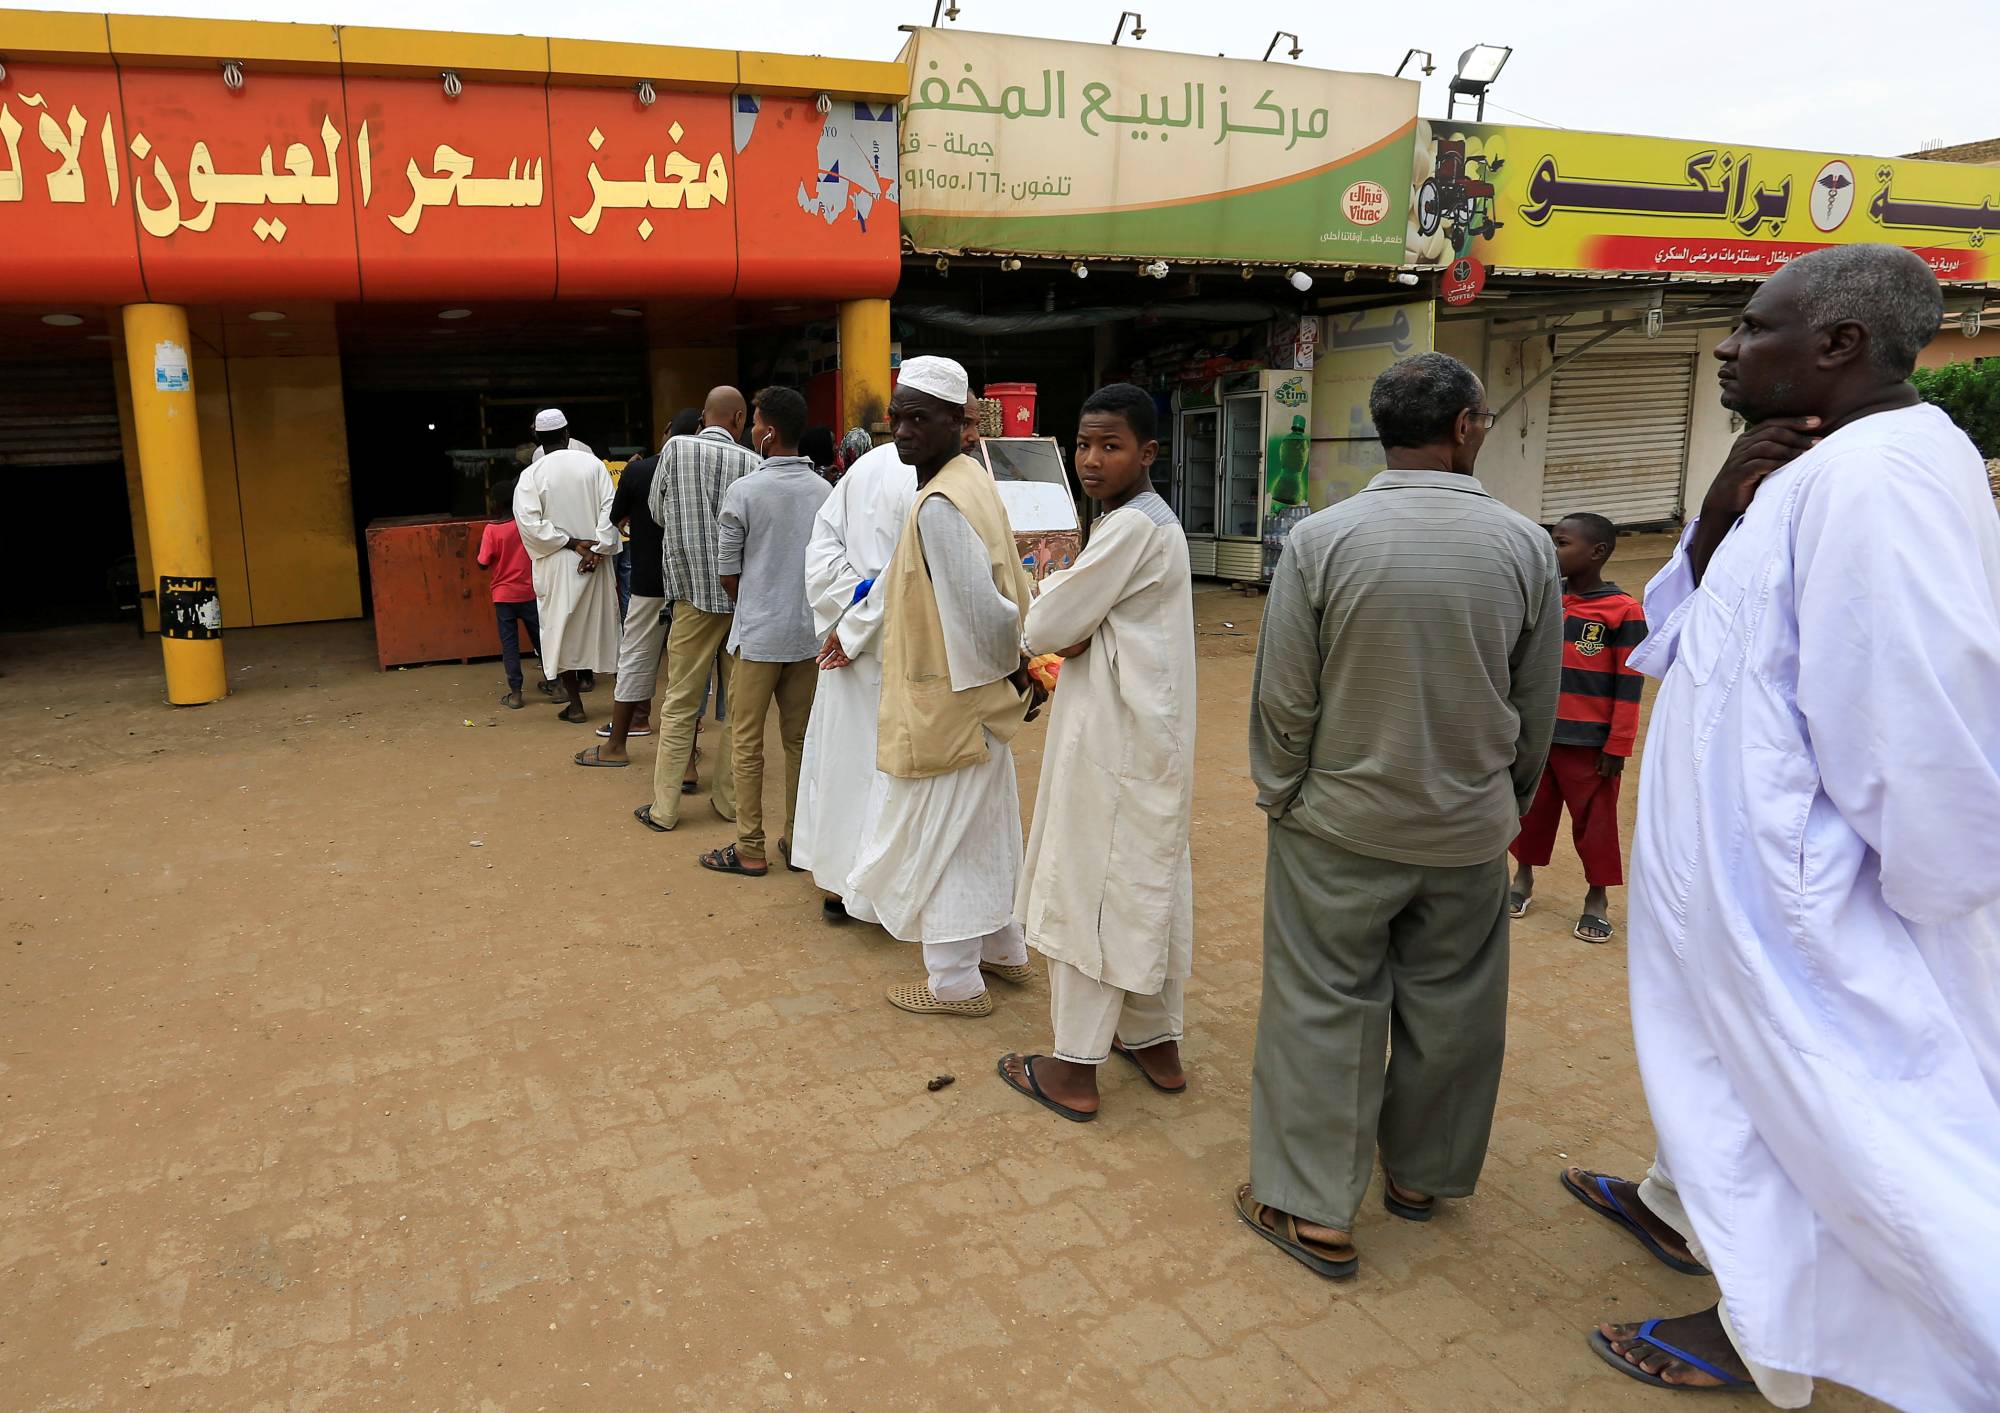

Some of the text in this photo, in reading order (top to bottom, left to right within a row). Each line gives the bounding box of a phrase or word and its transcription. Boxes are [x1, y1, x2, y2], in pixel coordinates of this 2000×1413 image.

[900, 60, 1329, 151] مركز البيع المخف
[872, 140, 880, 153] UP
[943, 132, 994, 163] جملة
[0, 92, 729, 244] مخبز سحر العيون الآل
[1518, 150, 1793, 236] برانكو
[1349, 205, 1381, 221] Vitrac
[1654, 246, 1690, 263] السكري
[1689, 247, 1719, 264] مرضى
[1718, 247, 1761, 265] مستلزمات
[1447, 292, 1476, 302] COFFTEA
[1275, 386, 1308, 401] Stim
